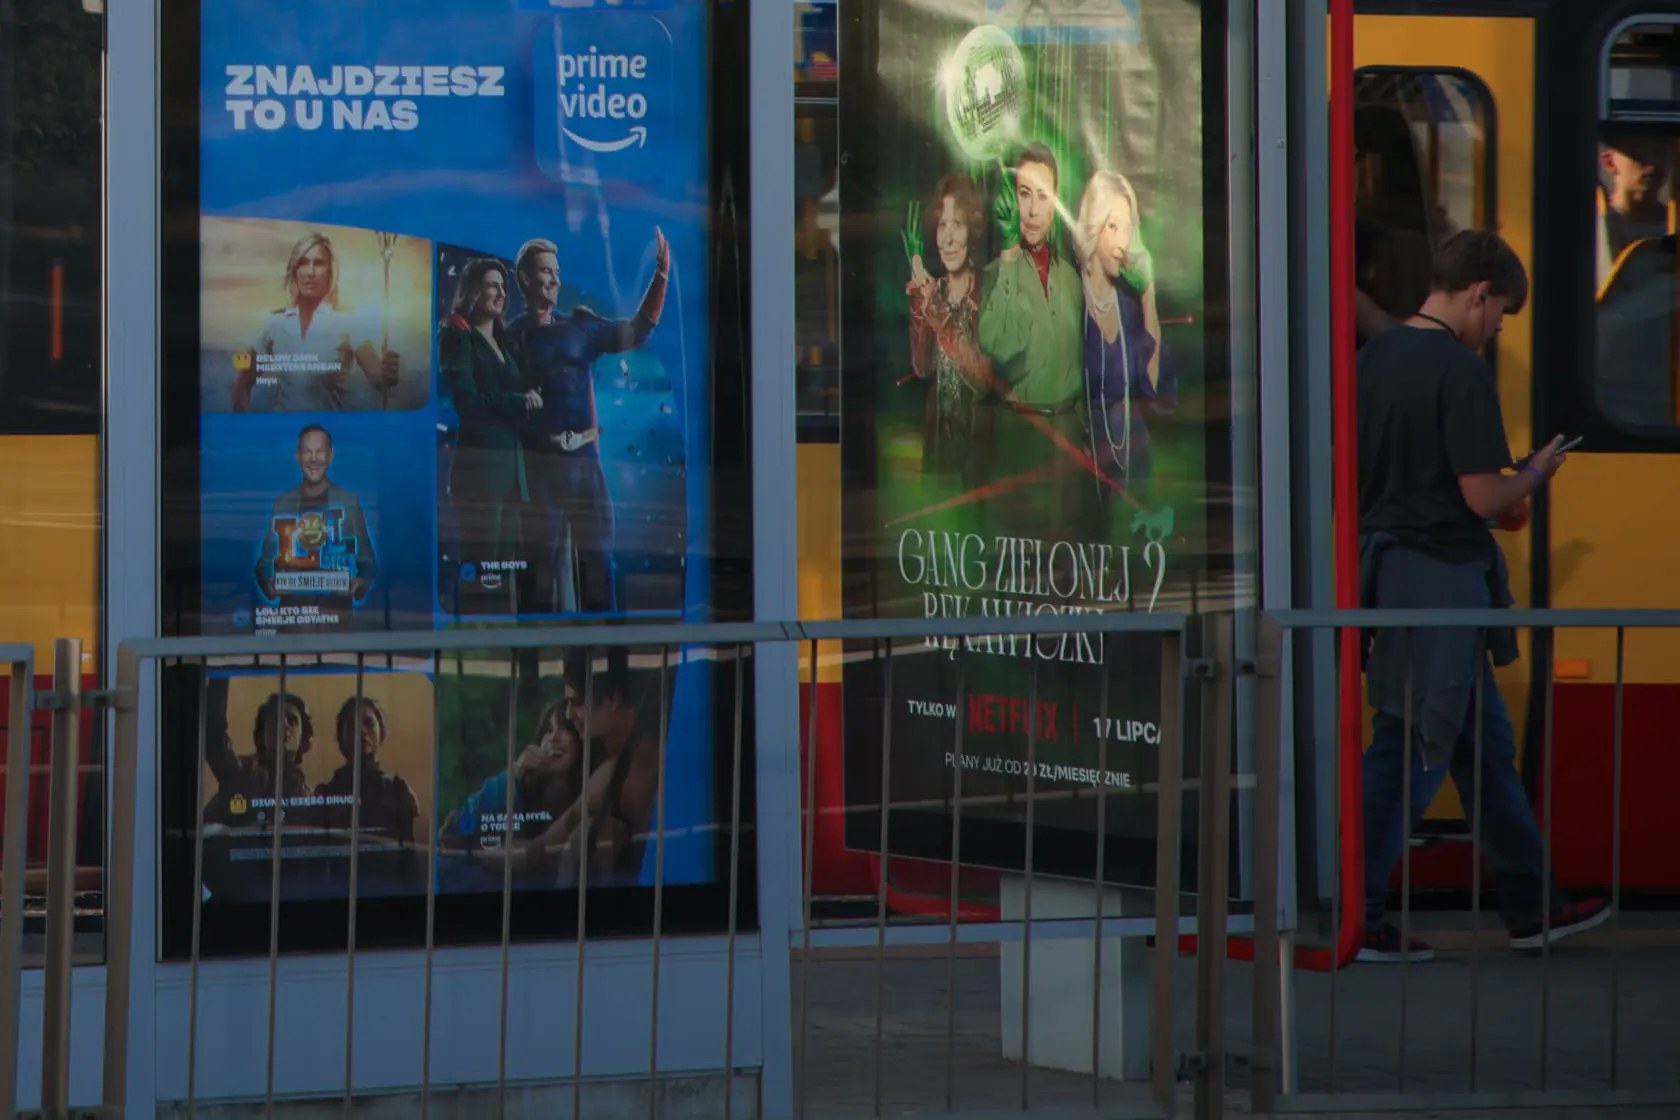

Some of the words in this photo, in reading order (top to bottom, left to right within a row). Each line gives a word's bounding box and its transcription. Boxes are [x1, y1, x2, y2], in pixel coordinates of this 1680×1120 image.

[225, 64, 505, 96] ZNAJDZIESZ
[558, 44, 647, 85] prime
[225, 100, 286, 130] TO
[295, 100, 323, 130] U
[332, 100, 419, 130] NAS
[559, 85, 648, 119] video
[898, 529, 986, 590] GANG
[994, 536, 1130, 602] ZIELONEJ
[907, 700, 944, 717] TYLKO
[969, 691, 1060, 745] NETFLIX
